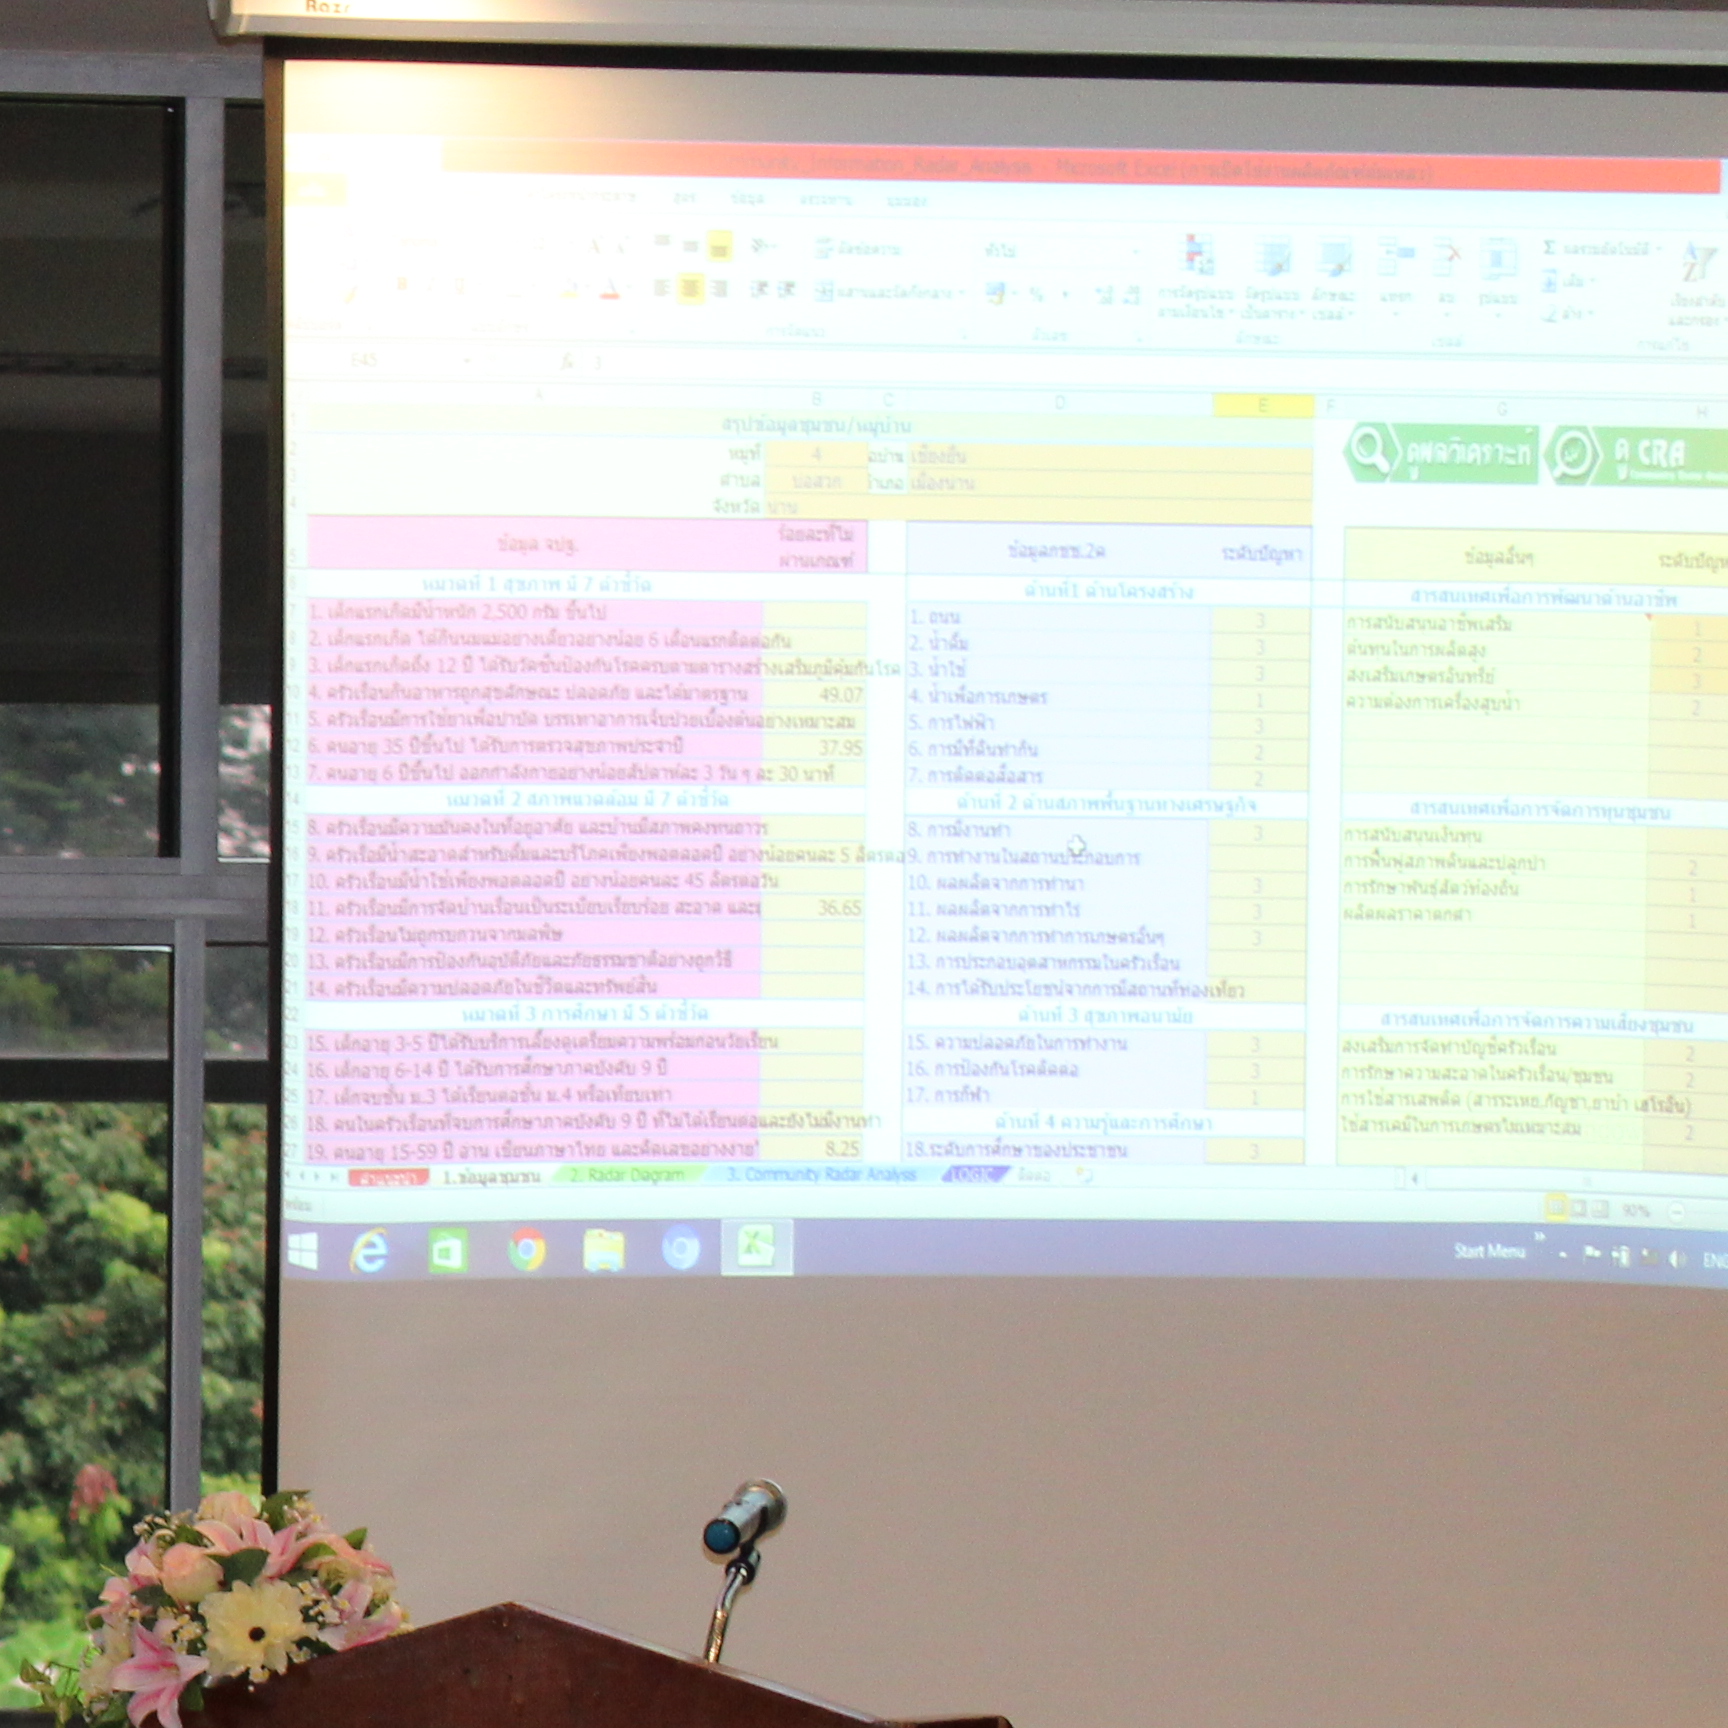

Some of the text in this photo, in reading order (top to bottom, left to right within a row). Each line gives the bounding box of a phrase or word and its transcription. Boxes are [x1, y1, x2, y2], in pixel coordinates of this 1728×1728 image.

[1638, 438, 1686, 466] CRA
[818, 685, 865, 704] 49.07
[818, 737, 865, 758] 37.95
[817, 898, 865, 917] 36.65
[824, 1138, 862, 1159] 8.25
[587, 1168, 685, 1185] Radar Diagram
[744, 1166, 918, 1183] Community Radar Analysis
[1453, 1242, 1527, 1260] Start Menu
